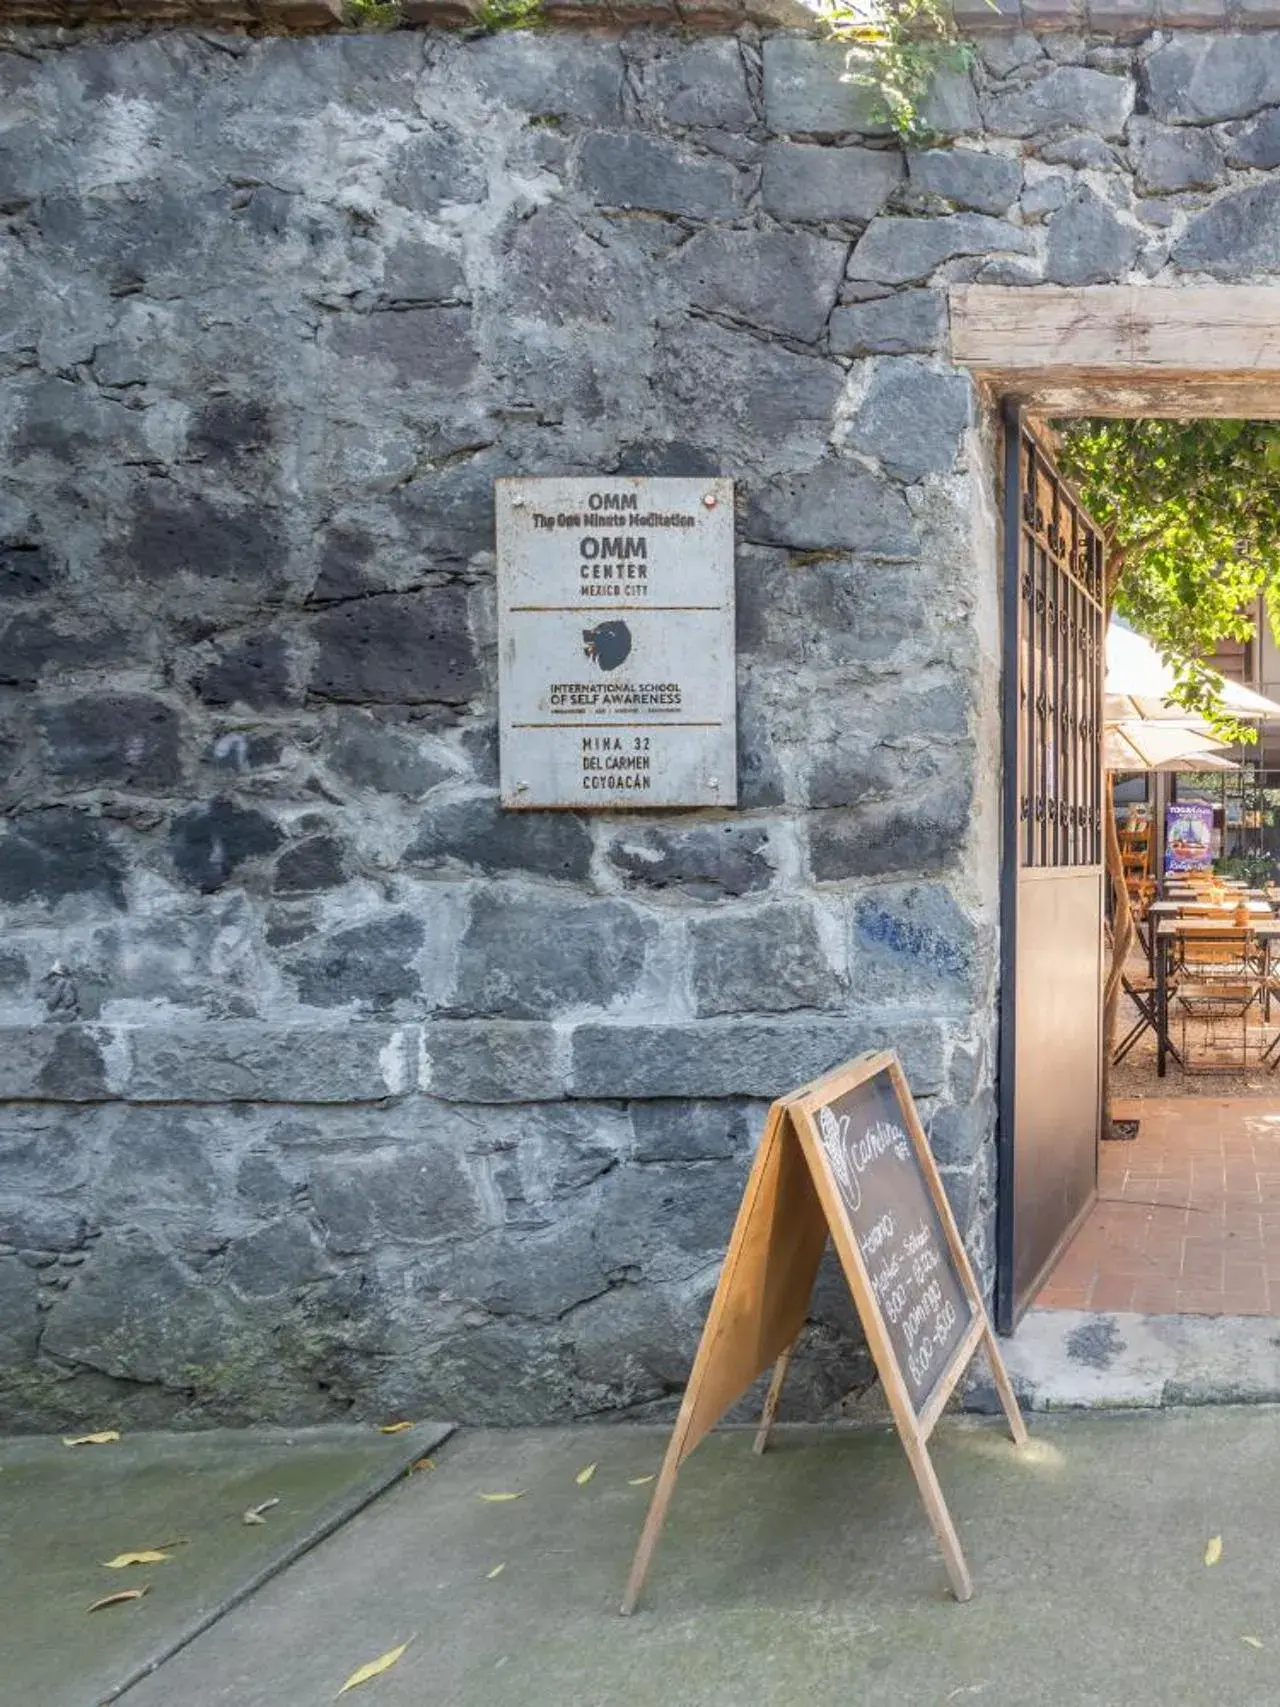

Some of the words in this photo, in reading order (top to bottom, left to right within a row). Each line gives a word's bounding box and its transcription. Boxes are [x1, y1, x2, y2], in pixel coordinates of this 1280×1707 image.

[588, 493, 638, 511] OMM
[533, 513, 555, 528] The
[557, 513, 580, 528] One
[583, 513, 627, 528] Minute
[629, 513, 695, 528] Meditation
[579, 536, 647, 560] OMM
[580, 564, 648, 579] CENTER
[581, 585, 620, 596] MEXICO
[624, 584, 648, 596] CITY
[550, 683, 635, 694] INTERNATIONAL
[639, 683, 681, 692] SCHOOL
[550, 694, 568, 705] OF
[570, 694, 600, 705] SELF
[602, 693, 681, 704] AWARENESS
[582, 737, 622, 750] MINA
[634, 737, 650, 750] 32
[583, 756, 603, 770] DEL
[605, 756, 650, 770] CARMEN
[583, 774, 651, 789] COYOACÁN
